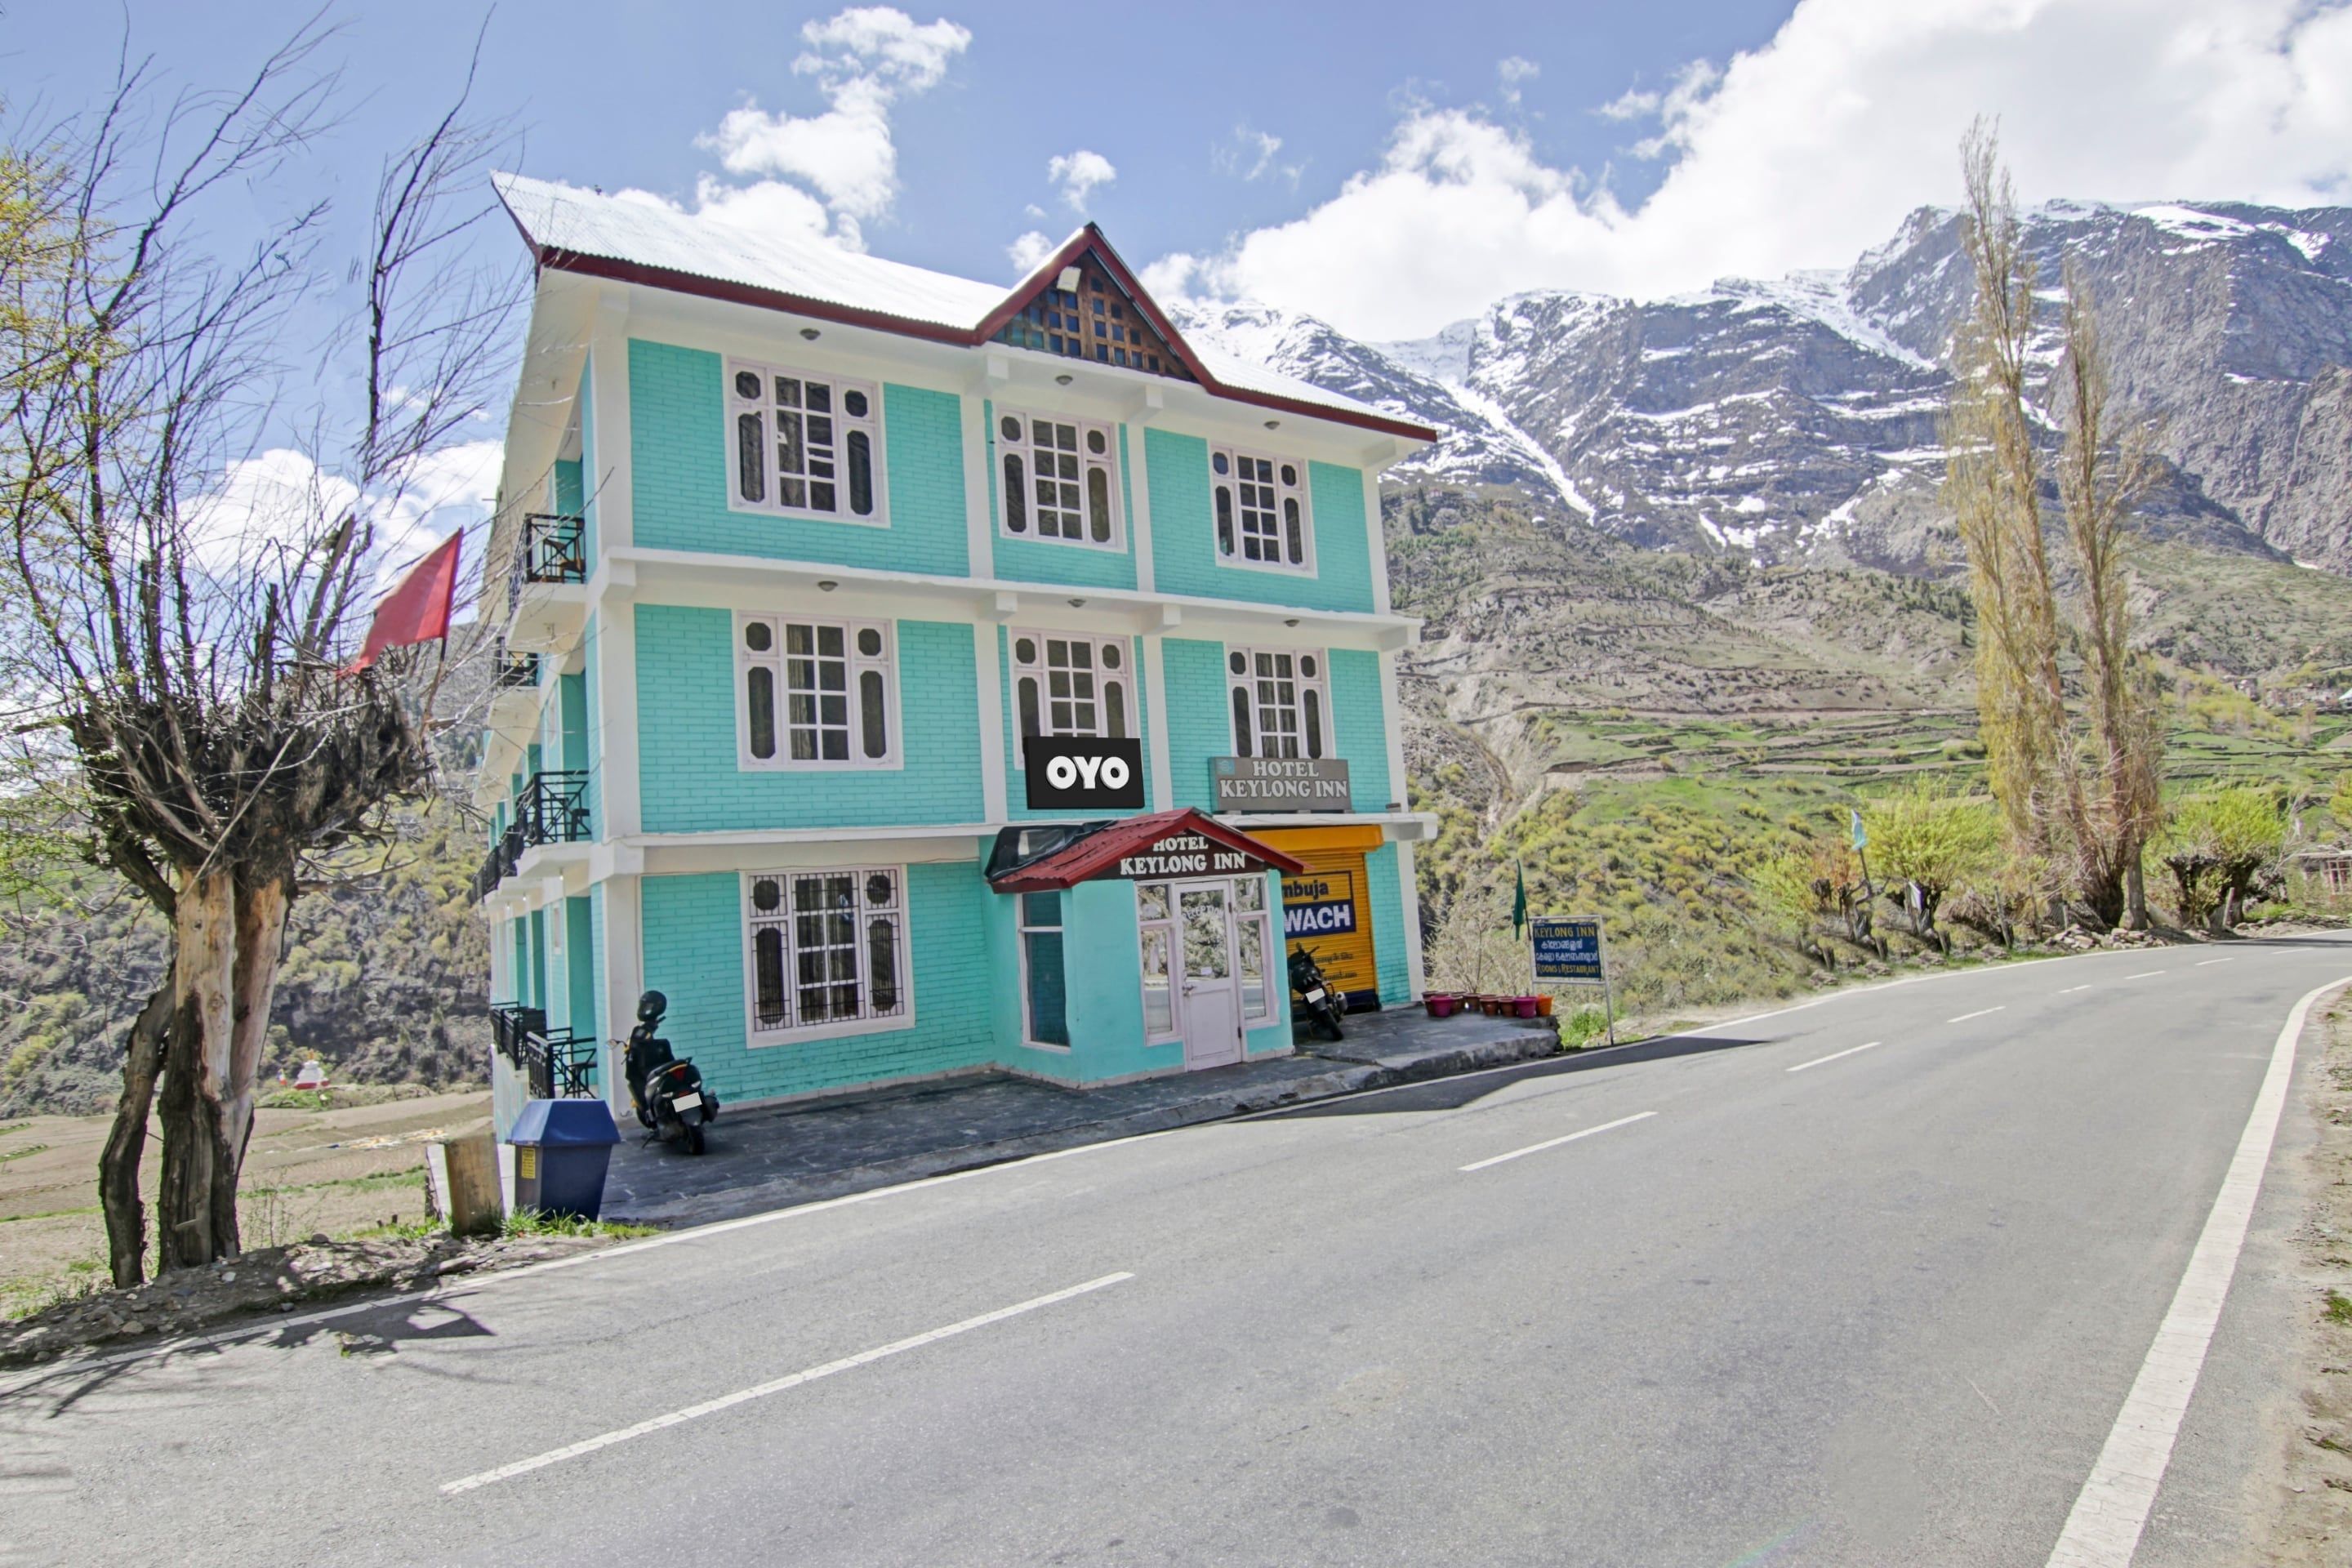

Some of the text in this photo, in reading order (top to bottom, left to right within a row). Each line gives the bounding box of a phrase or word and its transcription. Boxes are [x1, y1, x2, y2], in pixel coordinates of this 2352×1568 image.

[1046, 755, 1129, 790] OYO
[1252, 760, 1320, 777] HOTEL
[1219, 780, 1348, 798] KEYLONG INN
[1152, 836, 1209, 852] HOTEL
[1120, 852, 1246, 875] KEYLONG INN
[1535, 927, 1595, 938] KEYLONG INN
